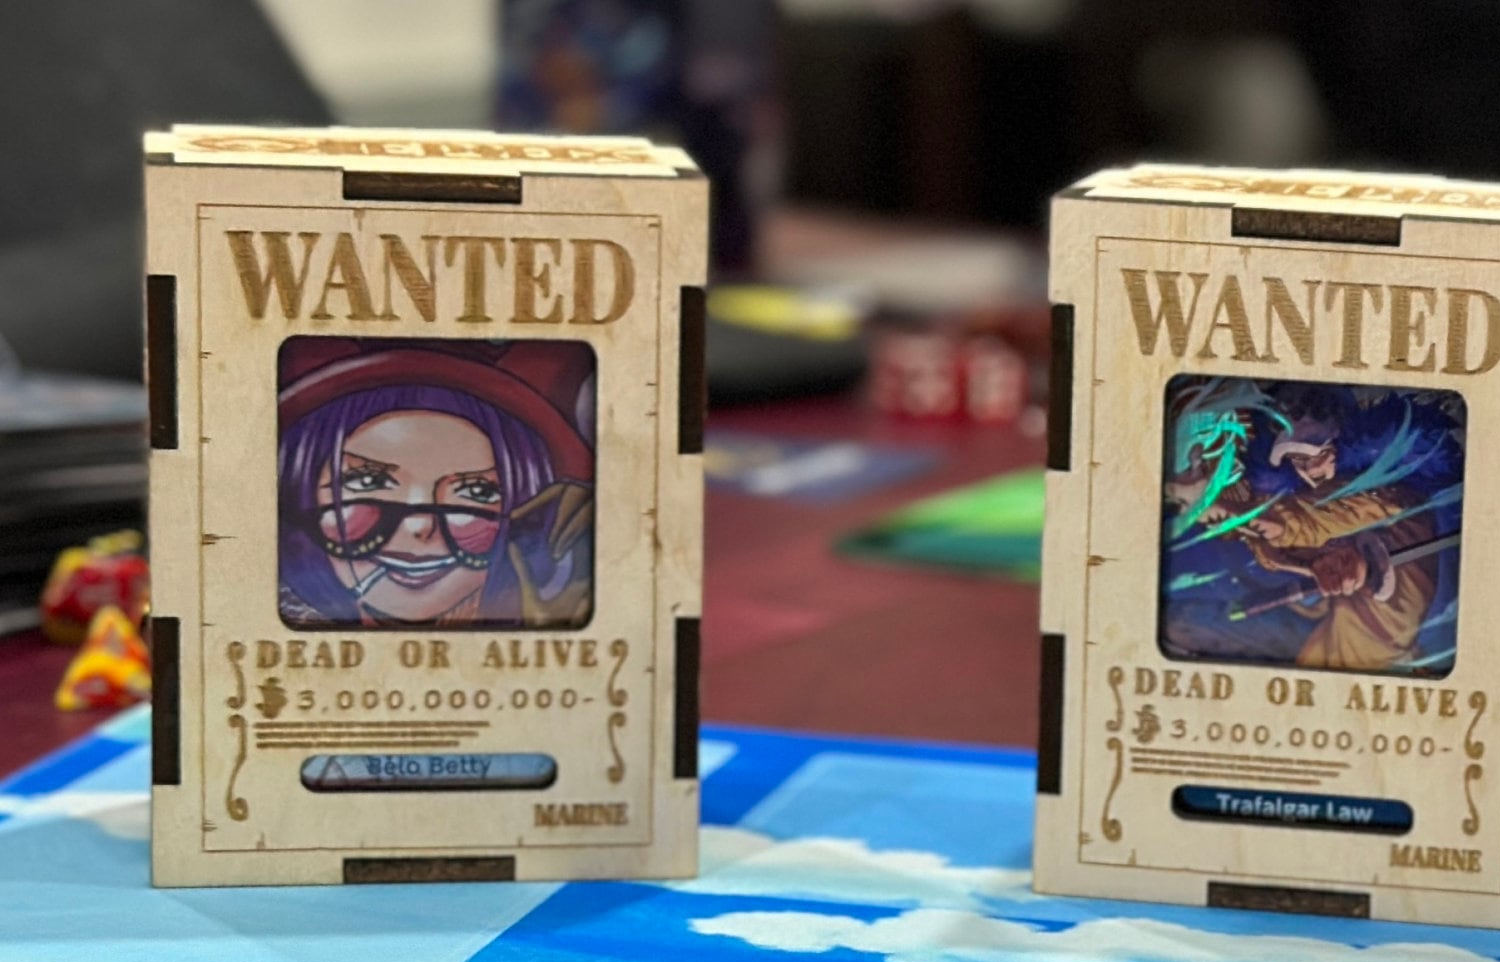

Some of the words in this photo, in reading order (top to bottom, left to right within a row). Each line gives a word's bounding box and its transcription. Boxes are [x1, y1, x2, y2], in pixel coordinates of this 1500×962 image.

[225, 230, 637, 325] WANTED
[255, 640, 365, 669] DEAD
[400, 640, 451, 668] OR
[482, 639, 599, 668] ALIVE
[1133, 667, 1235, 702] DEAD
[1265, 676, 1316, 707] OR
[1344, 684, 1458, 718] ALIVE
[428, 756, 491, 778] Betty
[534, 803, 629, 828] MARINE
[1216, 792, 1320, 822] Trafalgar
[1325, 802, 1374, 824] Law
[1389, 842, 1483, 873] MARINE
